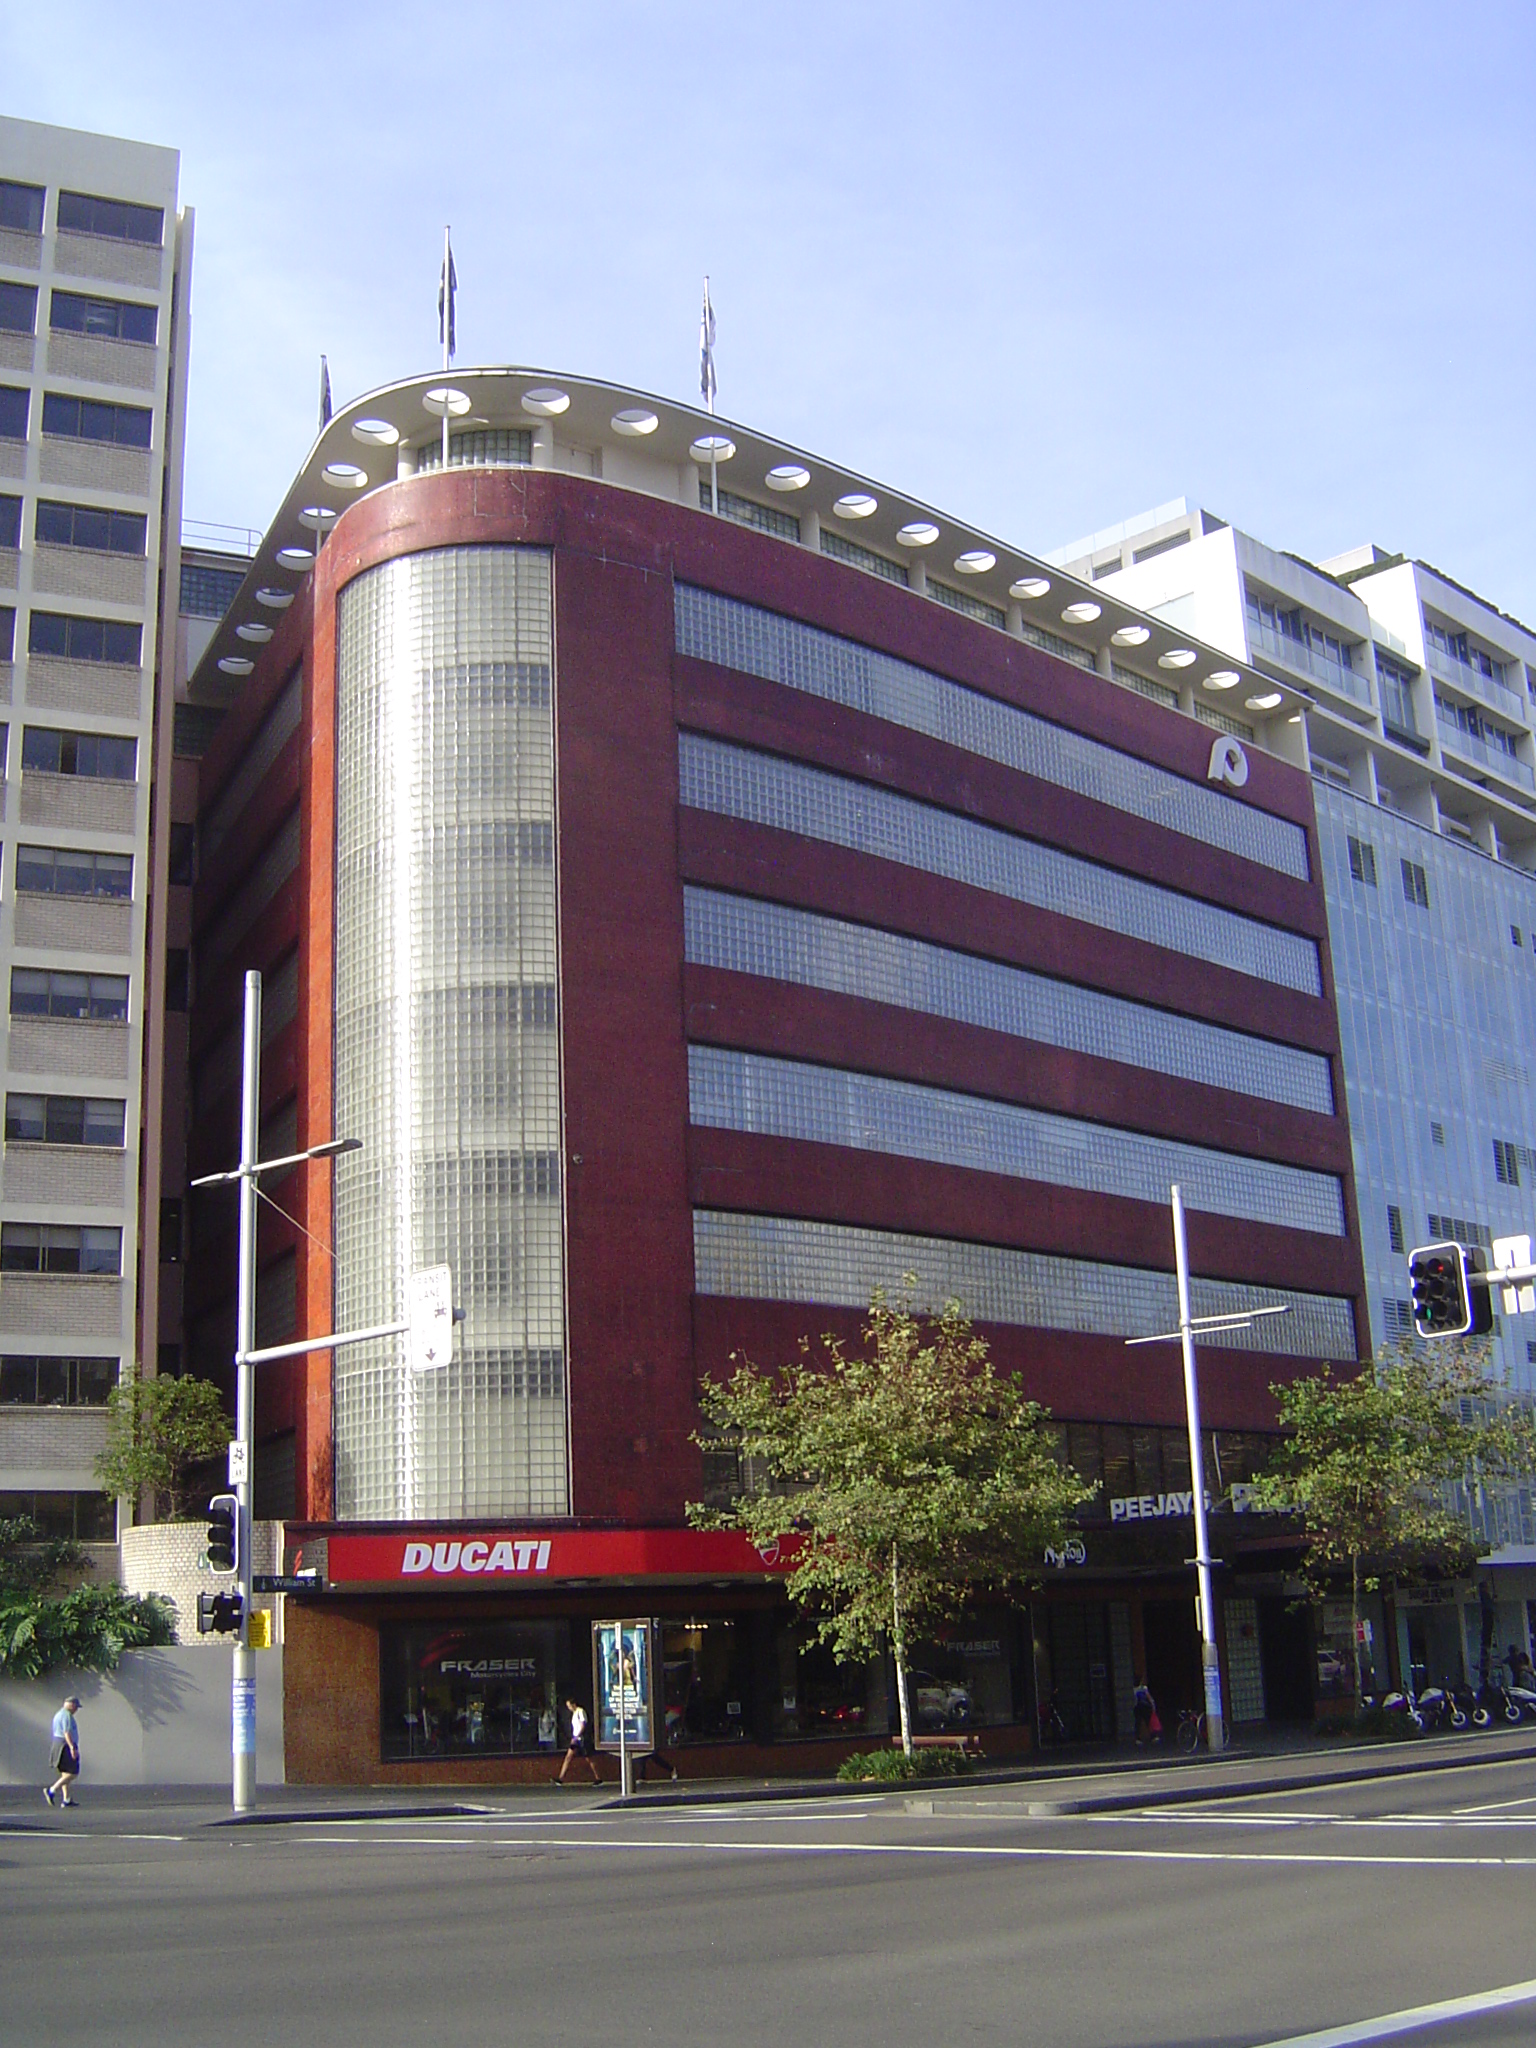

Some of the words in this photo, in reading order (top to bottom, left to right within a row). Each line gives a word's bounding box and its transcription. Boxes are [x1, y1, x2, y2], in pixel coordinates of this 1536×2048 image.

[401, 1540, 552, 1574] DUCATI
[272, 1577, 305, 1587] William
[307, 1577, 316, 1587] St
[440, 1657, 536, 1673] FRASER
